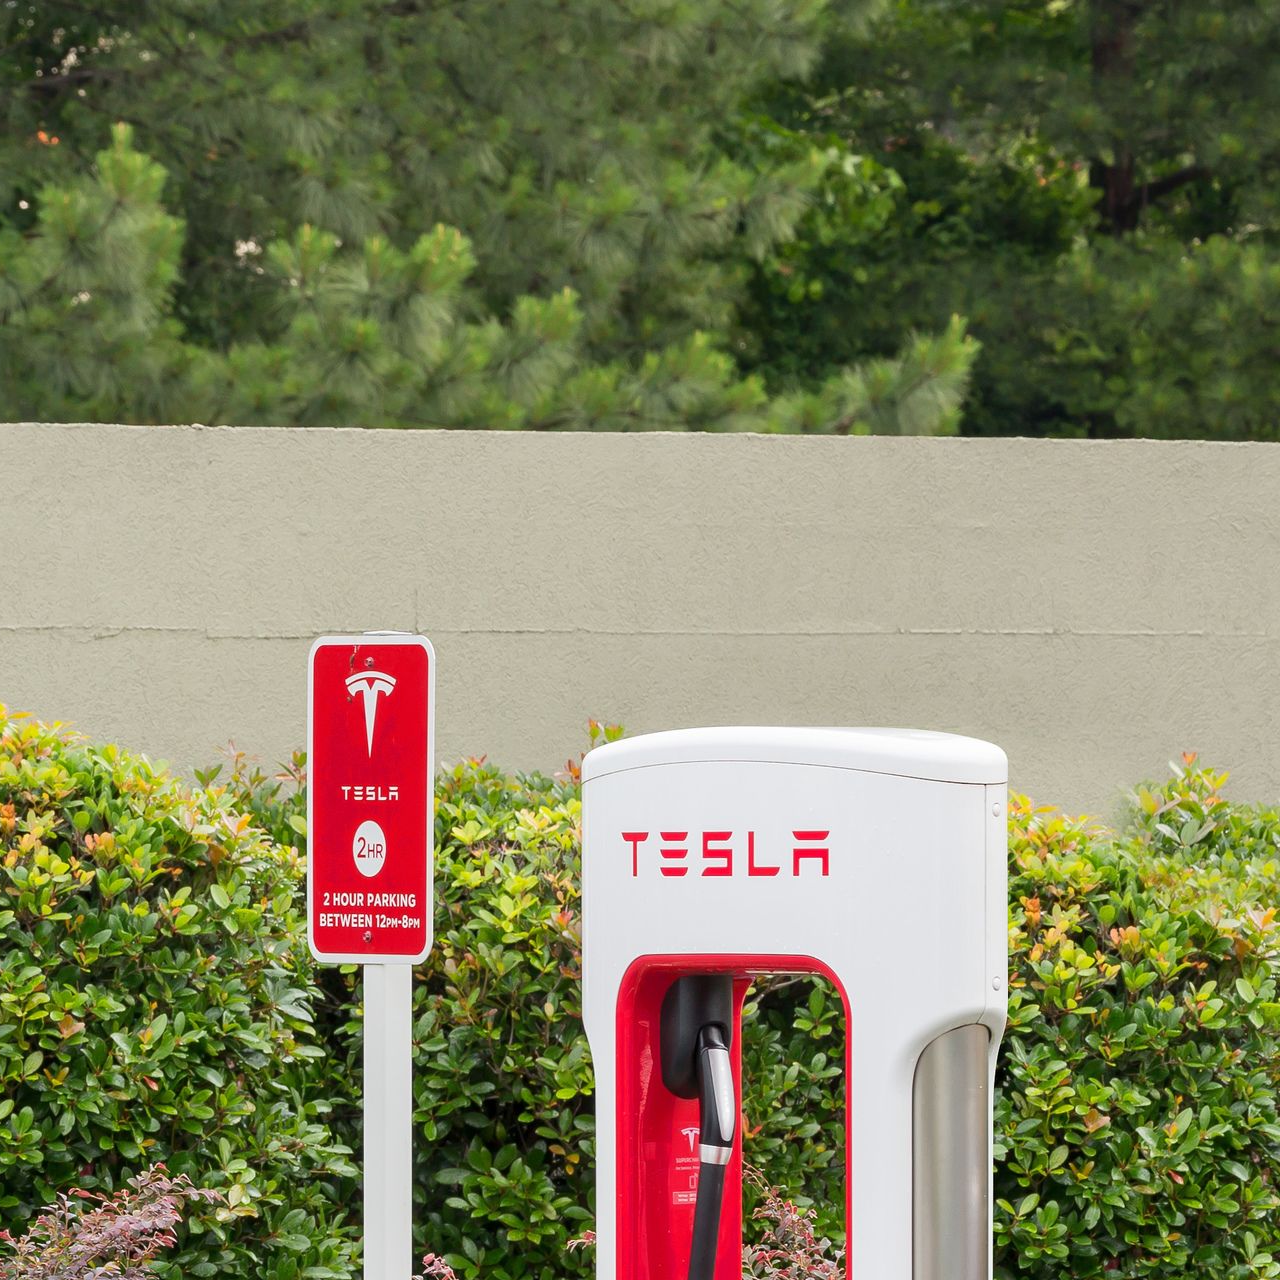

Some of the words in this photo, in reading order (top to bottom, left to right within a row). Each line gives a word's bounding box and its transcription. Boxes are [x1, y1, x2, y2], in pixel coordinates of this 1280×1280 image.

[341, 785, 399, 801] TESLA
[356, 836, 384, 859] 2HR
[621, 830, 830, 878] TESLA
[323, 893, 330, 907] 2
[332, 893, 364, 907] HOUR
[367, 893, 416, 908] PARKING
[319, 913, 373, 928] BETWEEN
